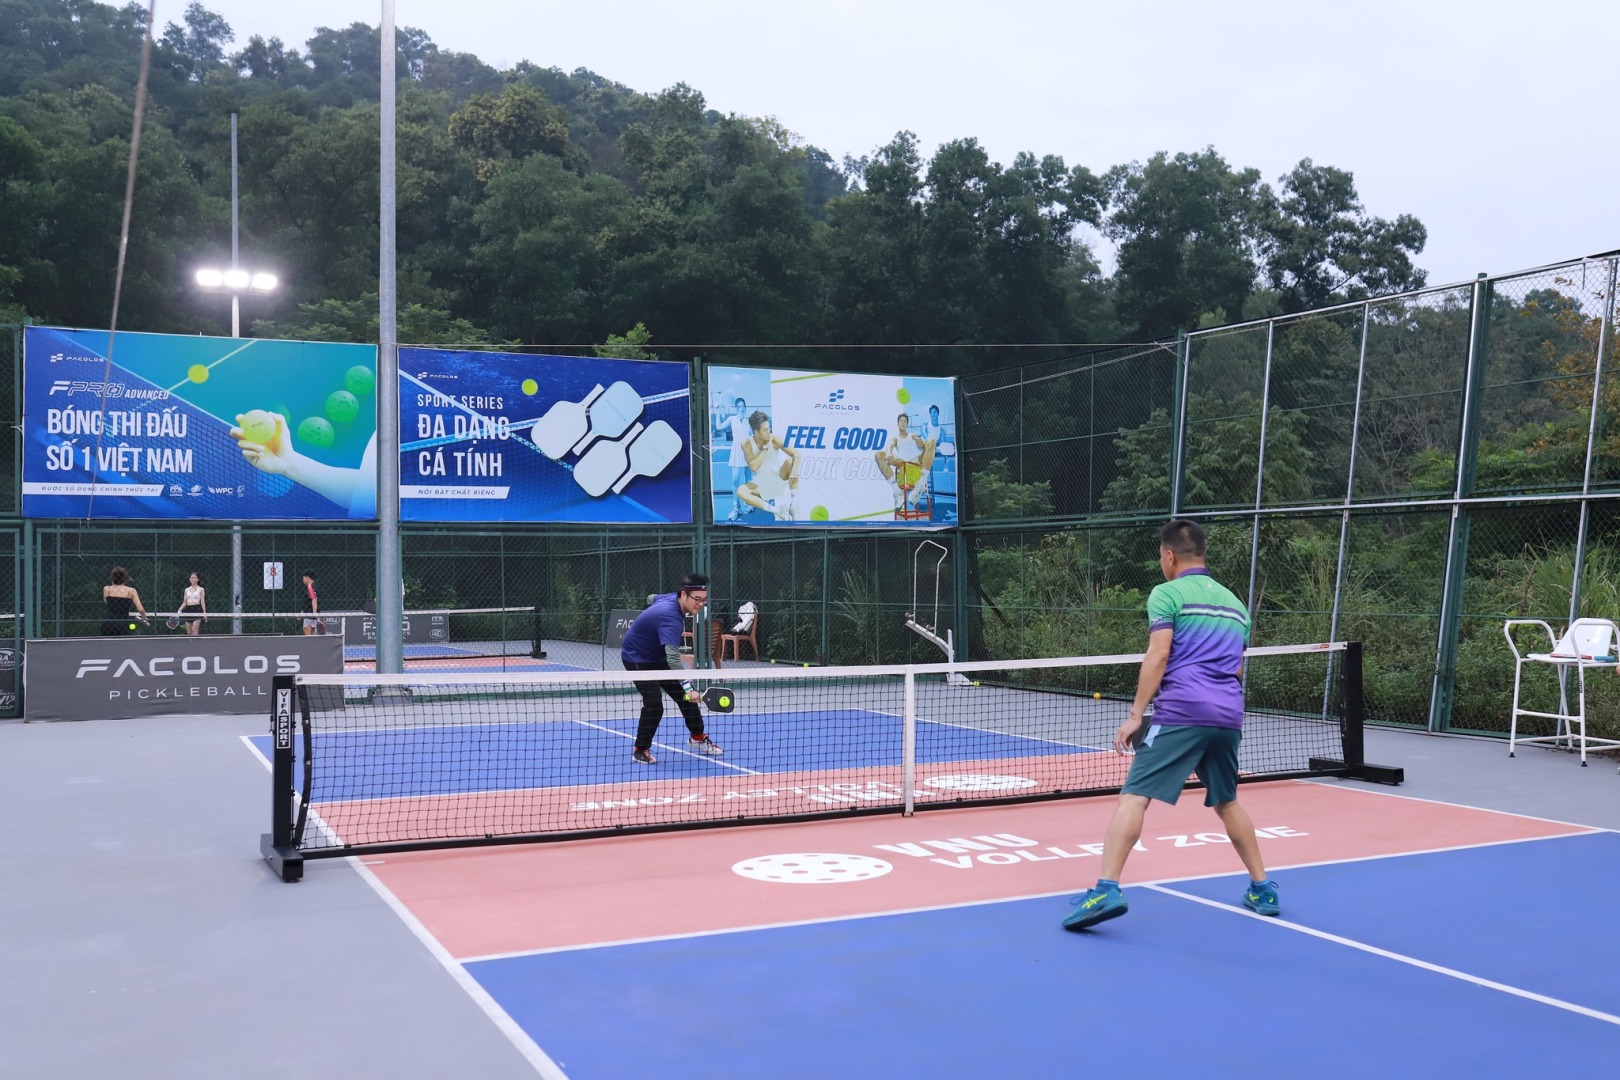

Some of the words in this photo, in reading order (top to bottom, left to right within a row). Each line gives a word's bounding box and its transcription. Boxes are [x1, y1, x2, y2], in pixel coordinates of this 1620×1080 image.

[124, 389, 169, 400] ADVANCED
[417, 394, 456, 408] SPORT
[461, 396, 504, 410] SERIES
[47, 405, 104, 436] BÓNG
[109, 411, 141, 437] THI
[146, 406, 187, 438] ĐẤU
[418, 414, 446, 439] ĐA
[454, 415, 510, 445] DẠNG
[784, 425, 826, 449] FEEL
[834, 427, 888, 451] GOOD
[46, 439, 78, 471] SỐ
[82, 447, 91, 471] 1
[97, 442, 143, 477] VIỆT
[147, 448, 193, 473] NAM
[418, 447, 447, 476] CÁ
[453, 448, 502, 477] TÍNH
[270, 566, 277, 577] 8
[76, 655, 301, 678] FACOLOS
[109, 686, 267, 700] PICKLEBALL
[571, 793, 707, 811] ZONE
[873, 833, 1040, 858] VNU
